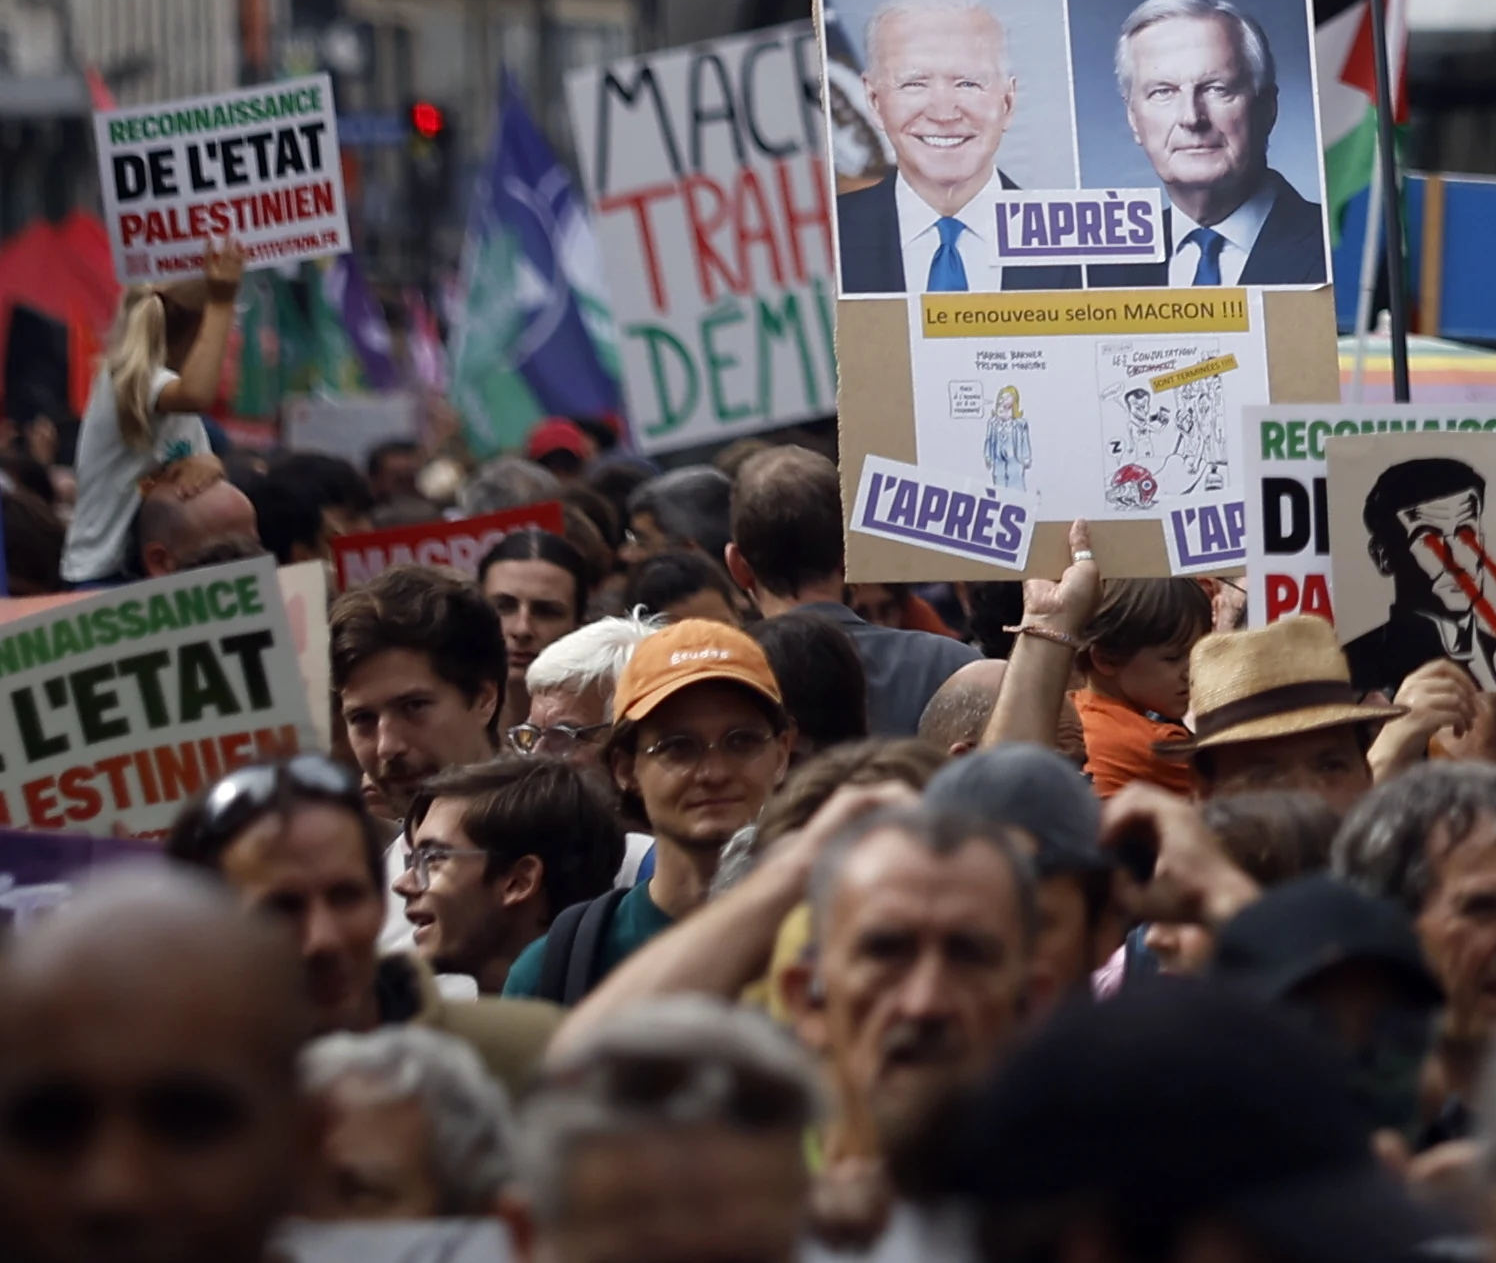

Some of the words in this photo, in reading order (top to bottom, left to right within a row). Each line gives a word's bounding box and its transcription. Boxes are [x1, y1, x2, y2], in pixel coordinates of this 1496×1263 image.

[109, 85, 325, 144] RECONNAISSANCE
[112, 148, 178, 203] DE
[186, 121, 325, 194] L'ETAT
[119, 181, 336, 247] PALESTINIEN
[995, 191, 1156, 257] L'APRÈS
[926, 306, 947, 324] Le
[954, 309, 1058, 323] renouveau
[1065, 304, 1117, 321] selon
[1123, 302, 1214, 320] MACRON
[1221, 300, 1244, 318] !!!
[861, 472, 1027, 564] L'APRÈS
[11, 628, 275, 764] L'ETAT
